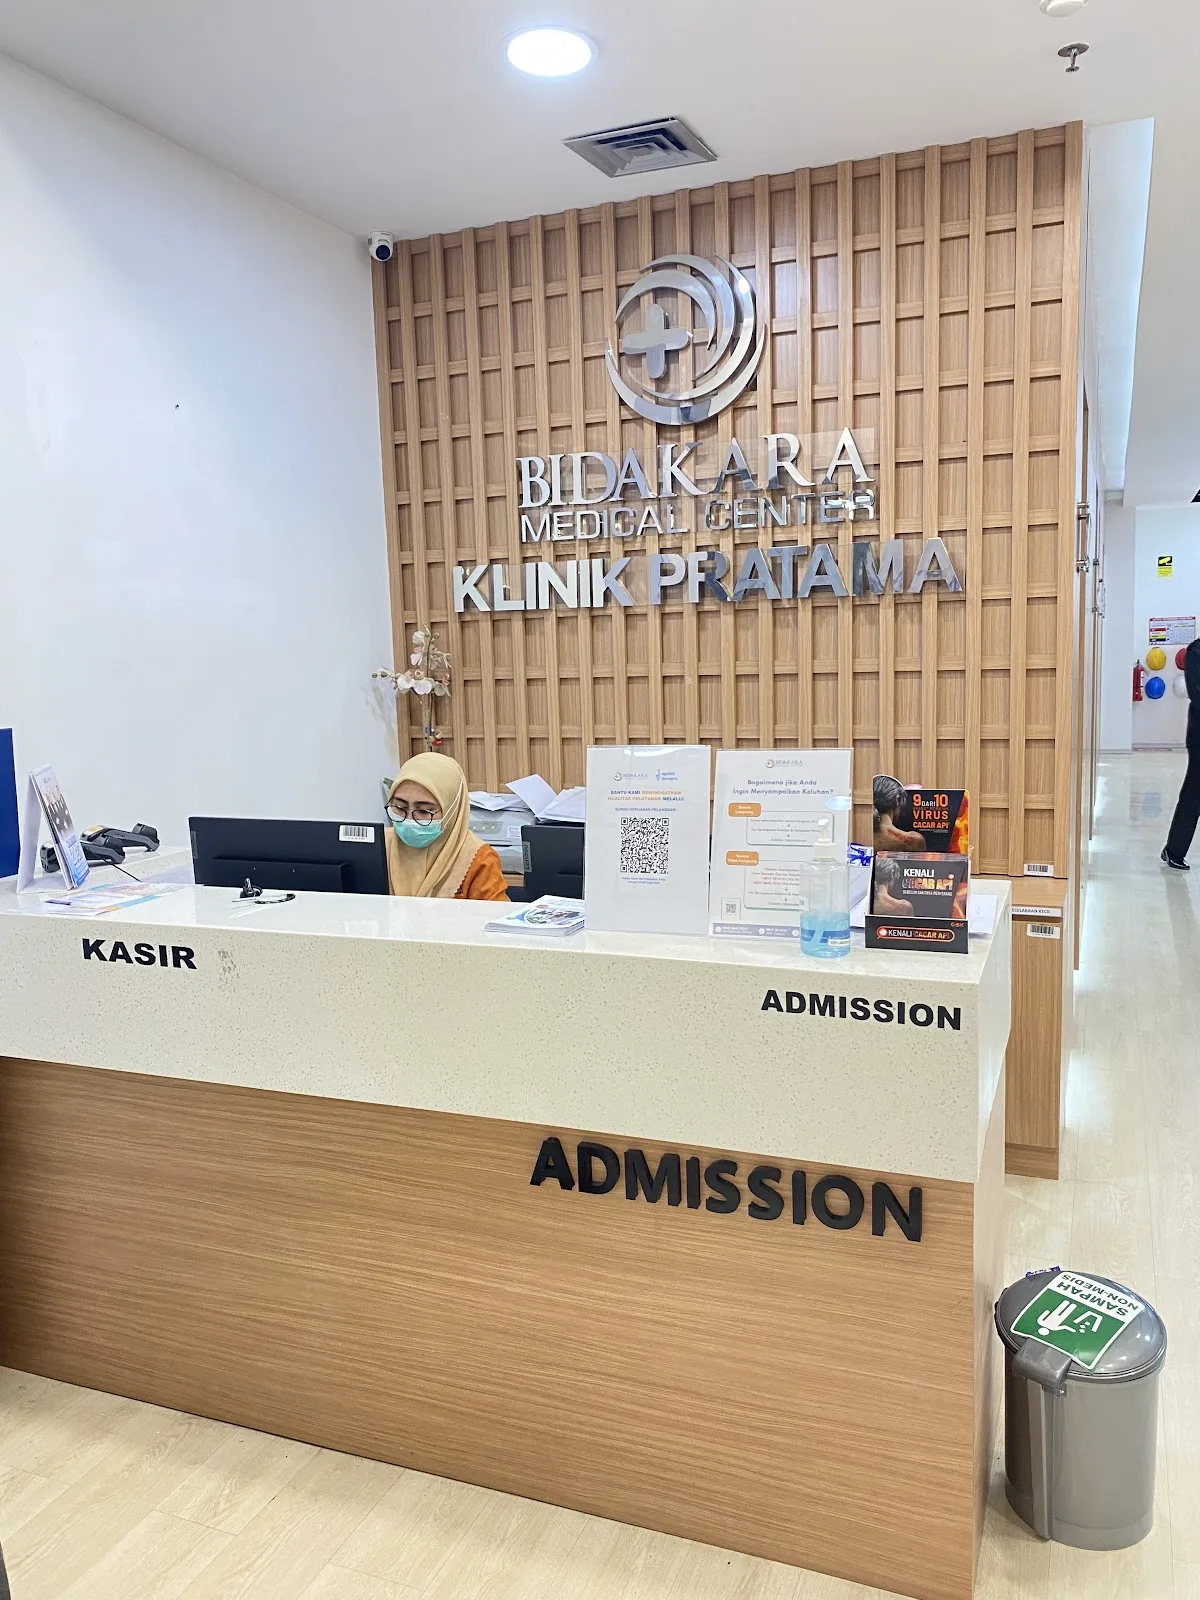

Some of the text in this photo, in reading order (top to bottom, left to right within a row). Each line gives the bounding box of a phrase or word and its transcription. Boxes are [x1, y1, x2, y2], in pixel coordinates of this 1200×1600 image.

[516, 427, 875, 508] BIDAKARA
[521, 489, 875, 543] MEDICAL CENTER
[453, 537, 963, 613] KLINIK PRATAMA
[913, 793, 921, 807] 9
[934, 793, 948, 807] 10
[913, 810, 948, 820] VIRUS
[902, 878, 935, 889] CACAR
[903, 868, 934, 878] KENALI
[888, 929, 912, 937] KENALI
[82, 938, 197, 969] KASIR
[761, 989, 961, 1030] ADMISSION
[530, 1136, 923, 1242] ADMISSION
[1056, 1282, 1128, 1317] SAMPAH
[1062, 1274, 1139, 1311] NON-MEDIS
